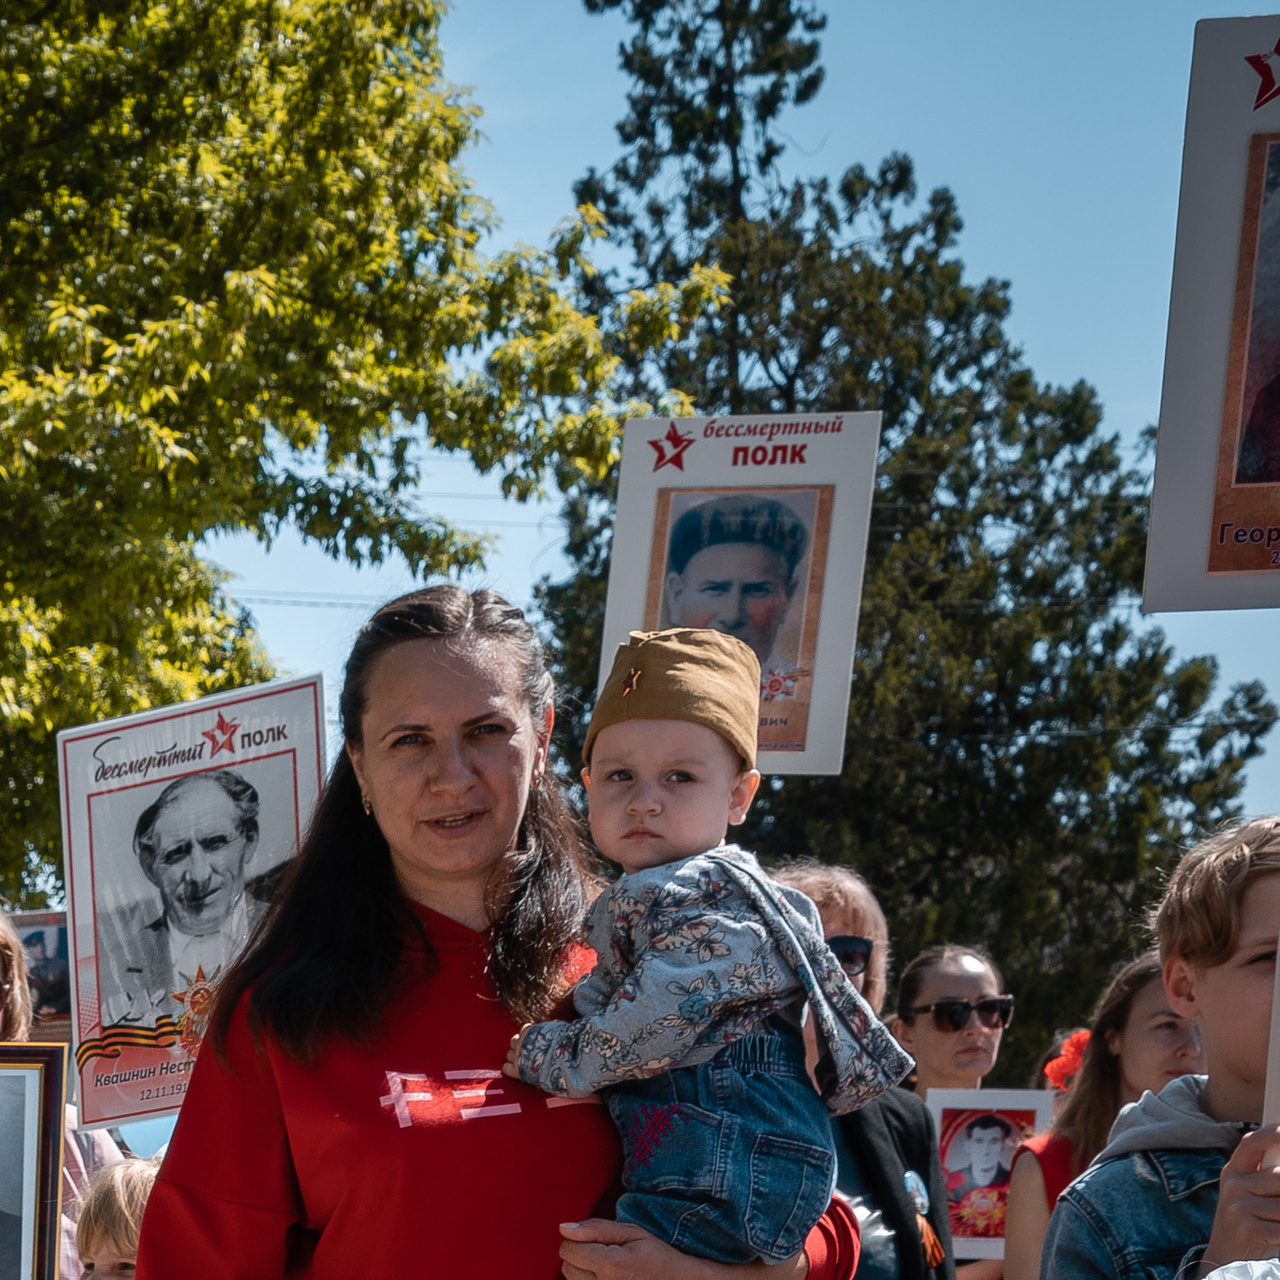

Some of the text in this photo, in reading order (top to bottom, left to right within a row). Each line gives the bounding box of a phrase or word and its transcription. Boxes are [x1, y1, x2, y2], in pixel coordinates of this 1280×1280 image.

[703, 416, 844, 441] бессмертный
[732, 444, 807, 466] ПОЛК
[93, 724, 288, 783] бессмертный ПОЛК
[95, 1060, 196, 1087] Квашнин Нест
[140, 1083, 187, 1101] 12.11.191
